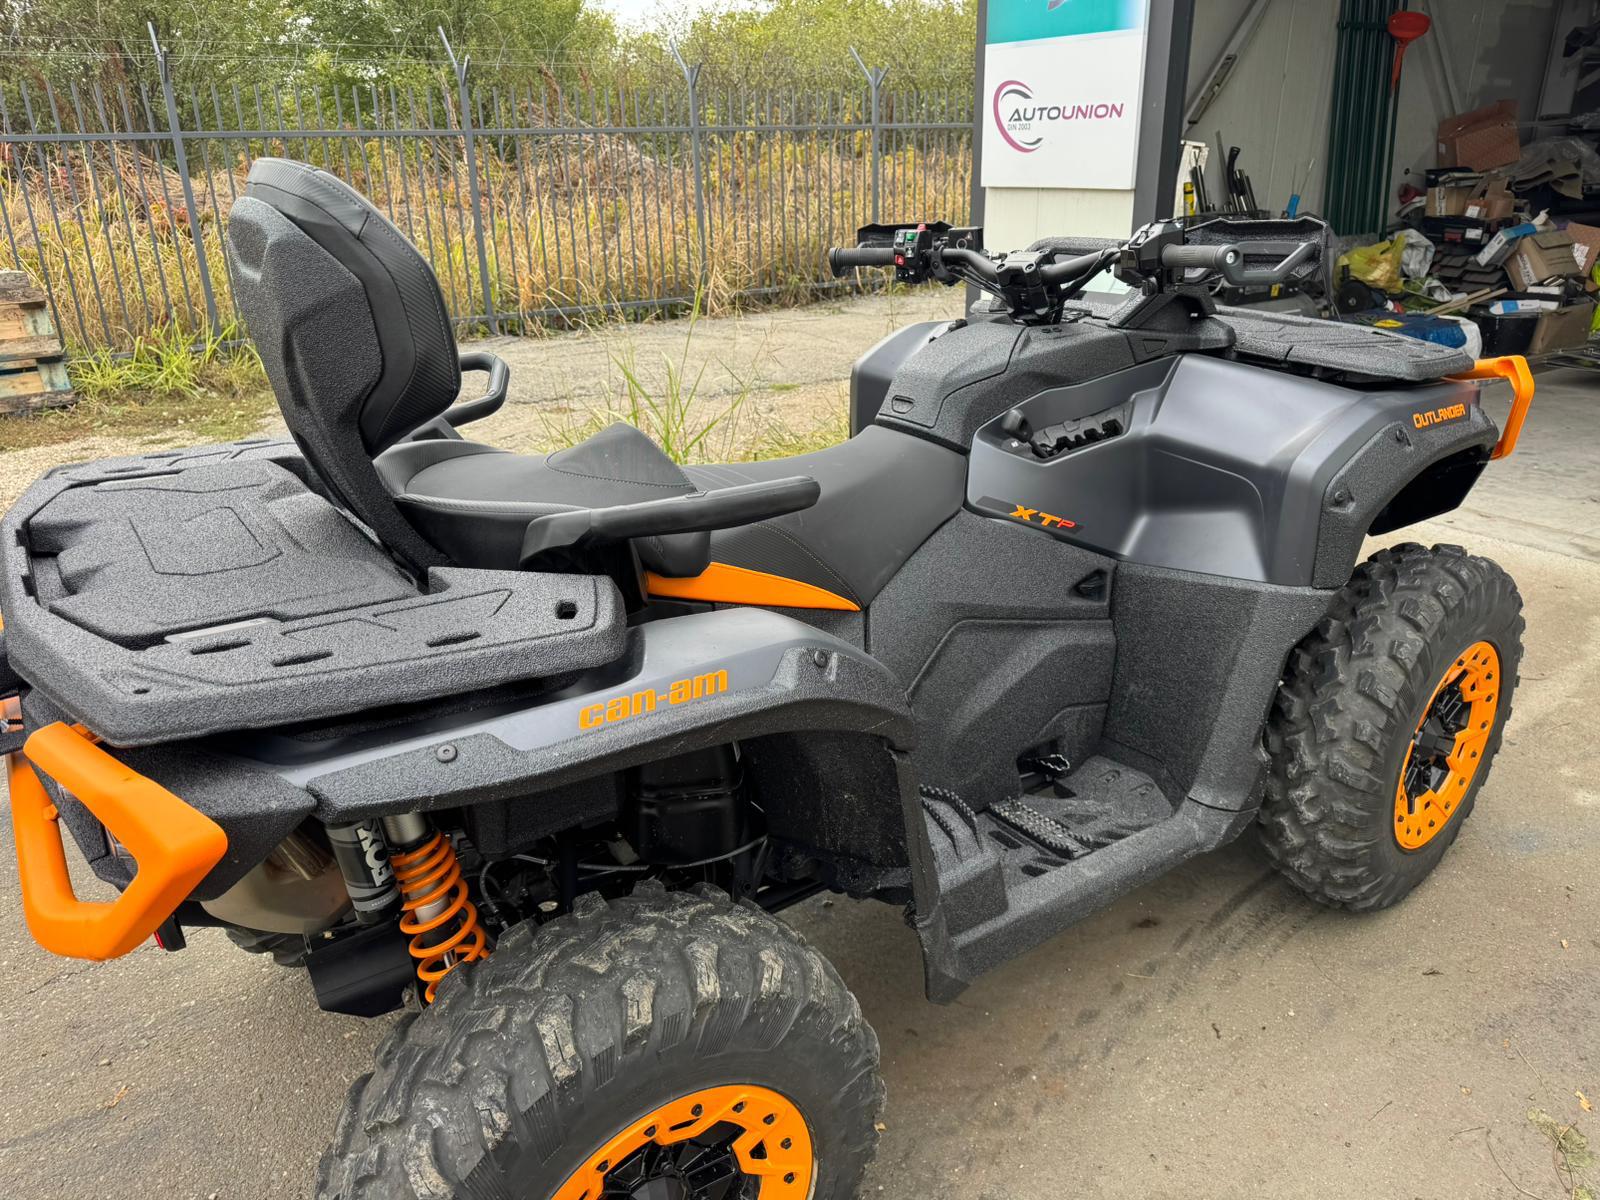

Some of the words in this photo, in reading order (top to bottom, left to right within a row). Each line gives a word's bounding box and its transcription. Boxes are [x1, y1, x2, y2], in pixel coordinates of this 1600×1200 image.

[1008, 103, 1124, 122] AUTOUNION
[1413, 403, 1466, 428] OUTLANDER
[579, 669, 728, 730] can-am
